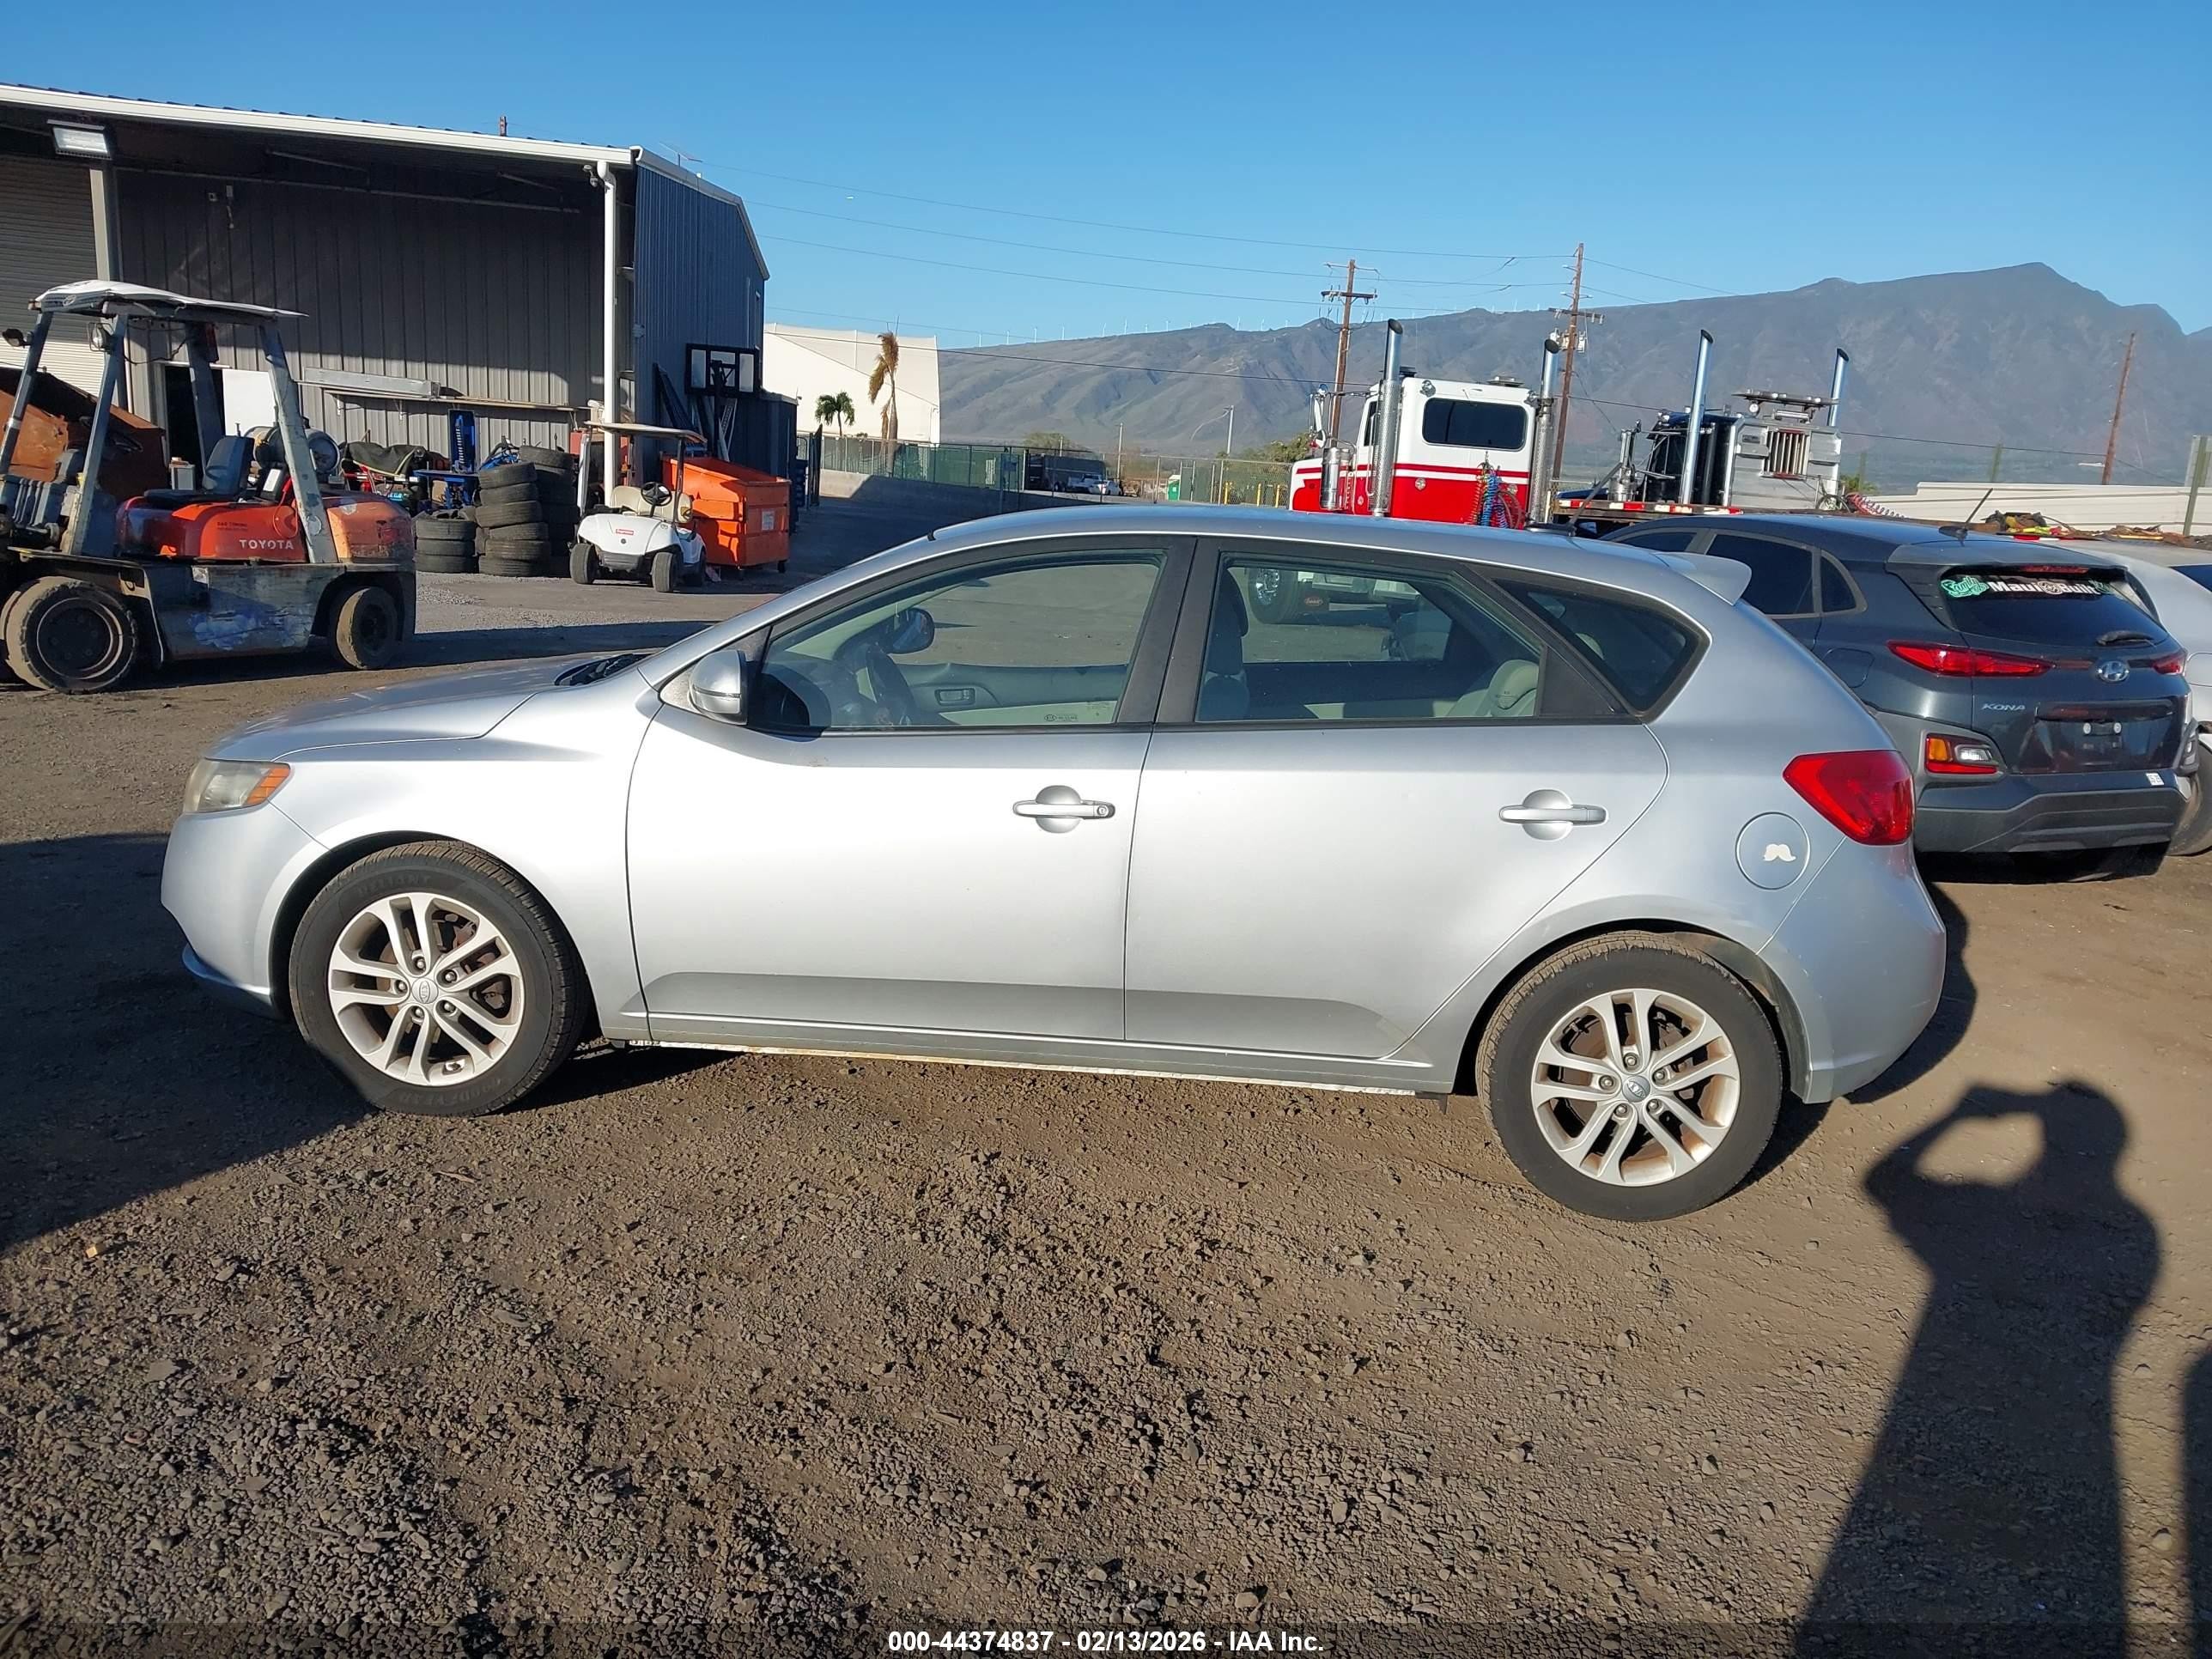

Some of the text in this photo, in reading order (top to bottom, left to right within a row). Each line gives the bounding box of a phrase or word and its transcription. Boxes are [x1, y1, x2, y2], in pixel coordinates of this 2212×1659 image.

[239, 539, 294, 550] TOYOTA
[1988, 581, 2043, 592] Maui
[2057, 583, 2101, 594] Built
